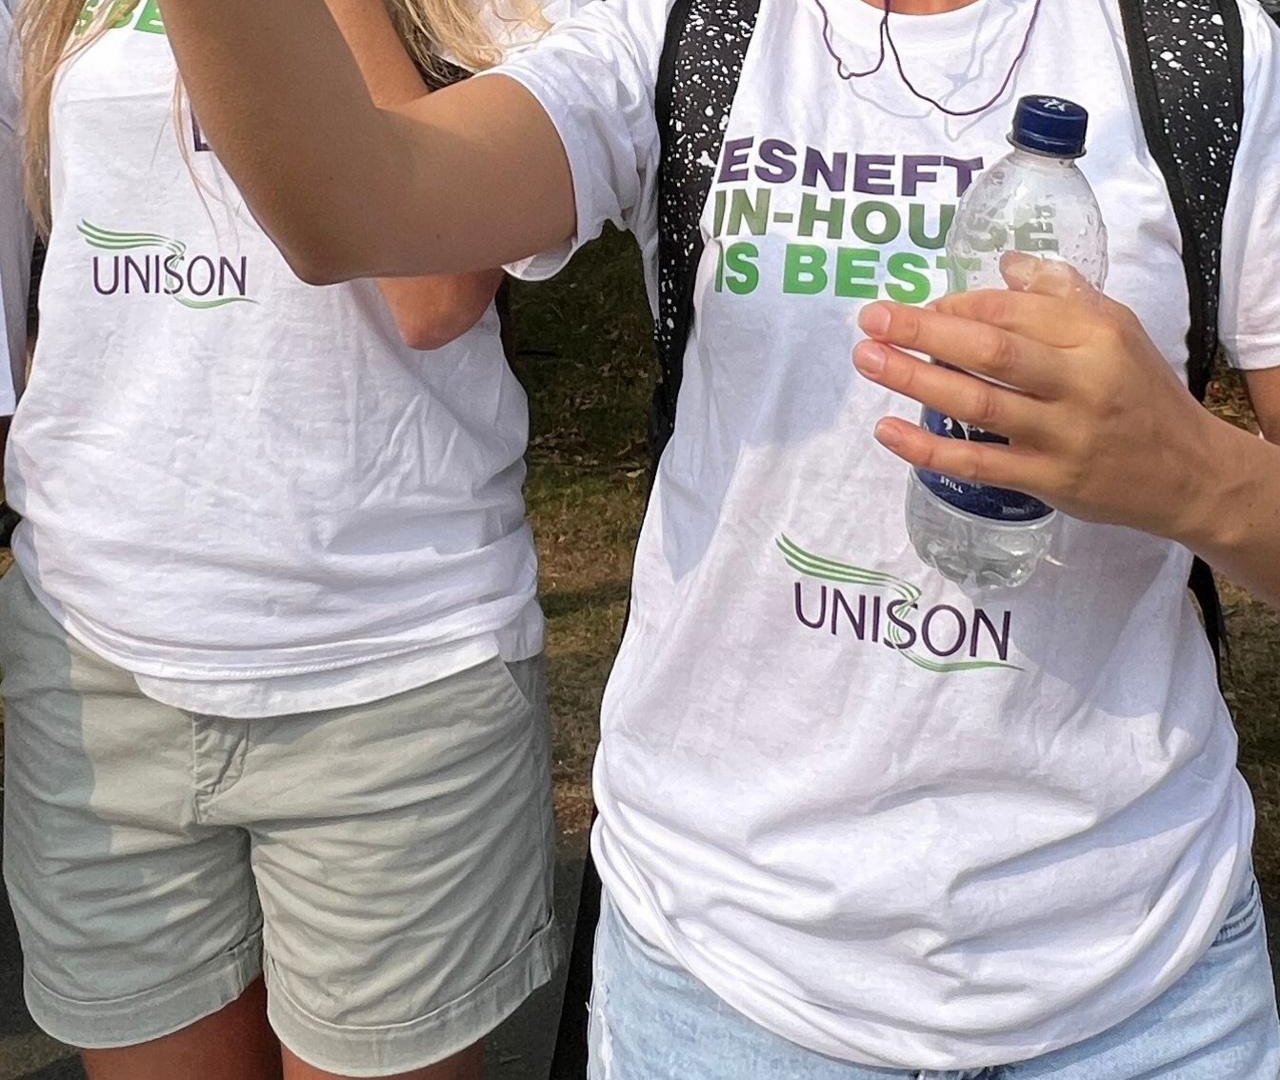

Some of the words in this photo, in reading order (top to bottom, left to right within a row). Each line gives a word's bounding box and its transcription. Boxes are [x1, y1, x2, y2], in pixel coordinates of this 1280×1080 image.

[92, 254, 248, 298] UNISON
[714, 240, 759, 296] IS
[939, 475, 964, 494] STILL
[793, 582, 1012, 661] UNISON
